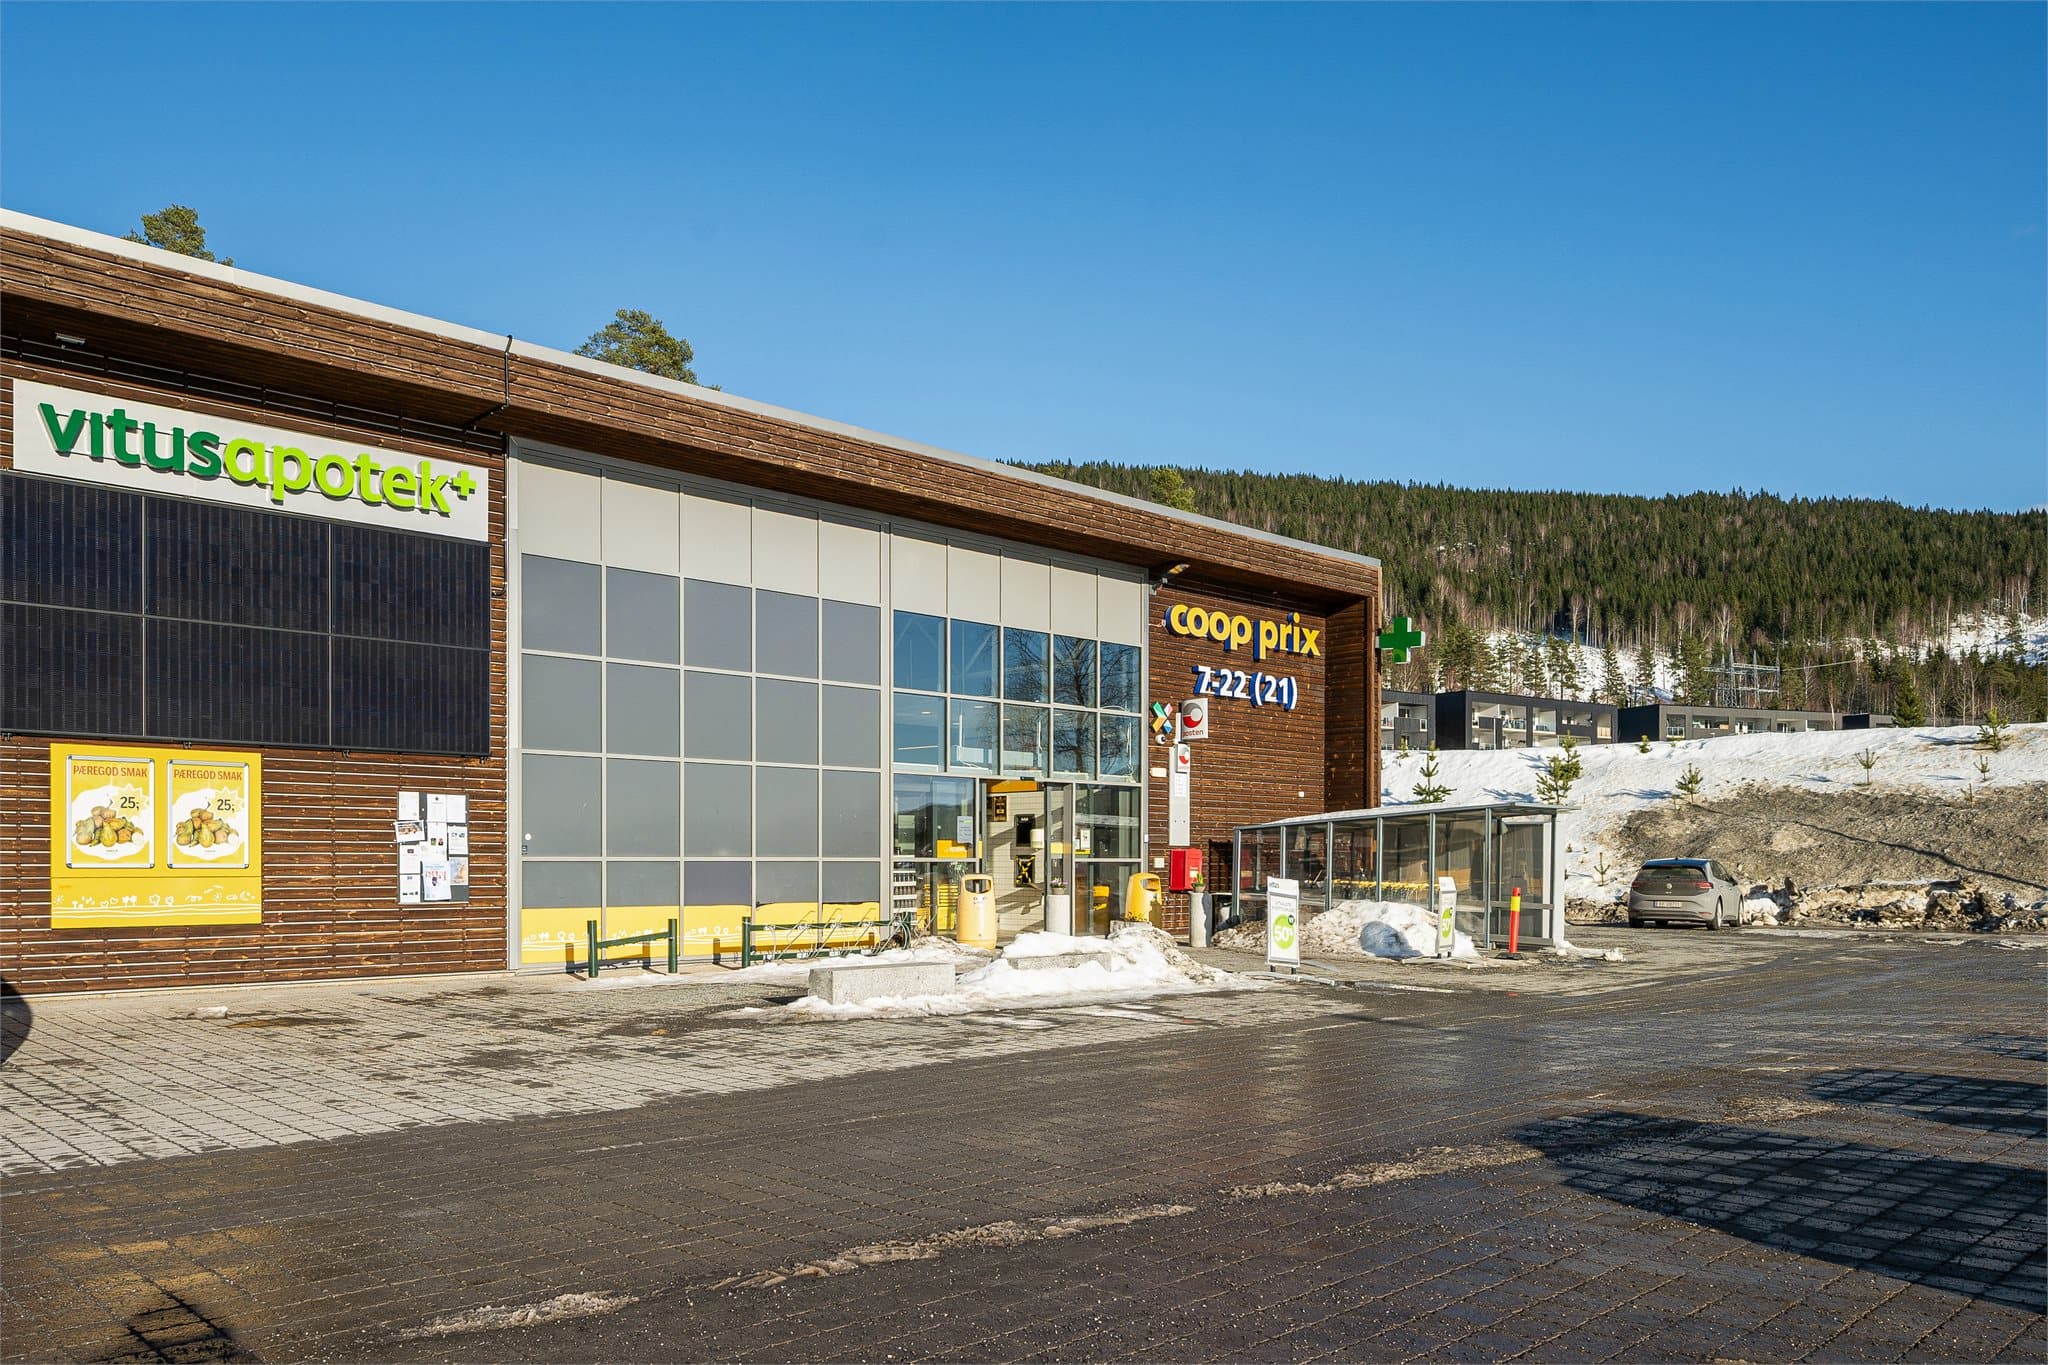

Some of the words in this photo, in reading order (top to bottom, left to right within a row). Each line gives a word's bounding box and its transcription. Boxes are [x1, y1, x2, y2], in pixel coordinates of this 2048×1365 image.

[1166, 604, 1251, 650] coop
[1255, 613, 1320, 659] prix
[1194, 666, 1250, 698] 7-22
[1251, 672, 1298, 710] (21)
[73, 765, 119, 776] PÆREGOD
[121, 767, 148, 778] SMAK
[174, 769, 216, 779] PÆREGOD
[217, 770, 242, 781] SMAK
